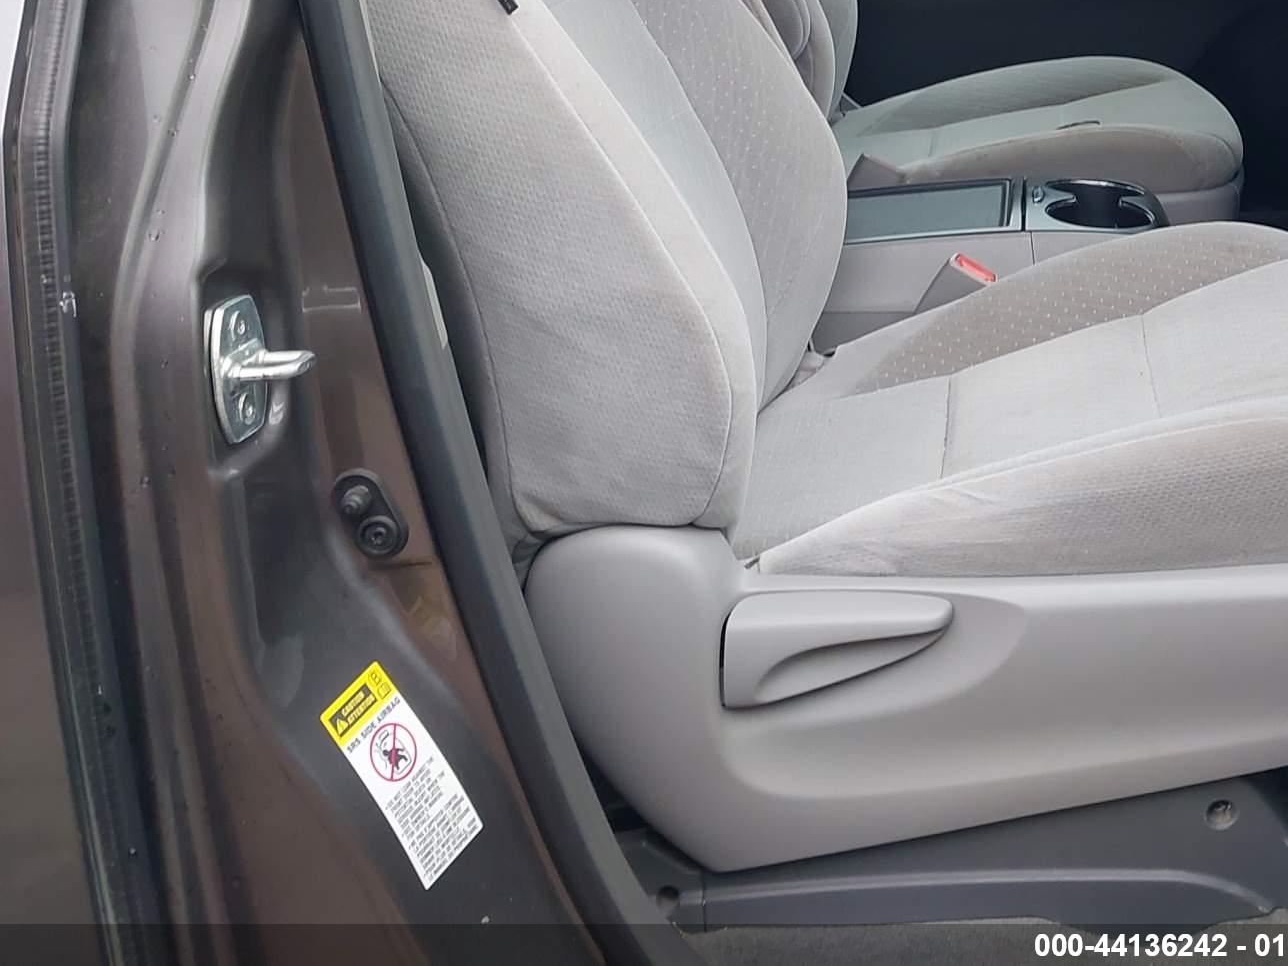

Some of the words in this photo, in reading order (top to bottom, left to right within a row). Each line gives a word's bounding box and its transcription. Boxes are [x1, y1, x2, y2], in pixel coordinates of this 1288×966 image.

[341, 690, 365, 717] CAUTION
[346, 694, 376, 725] ATTENTION
[346, 736, 361, 753] SRS
[360, 720, 377, 739] SIDE
[376, 696, 401, 724] AIRBAG
